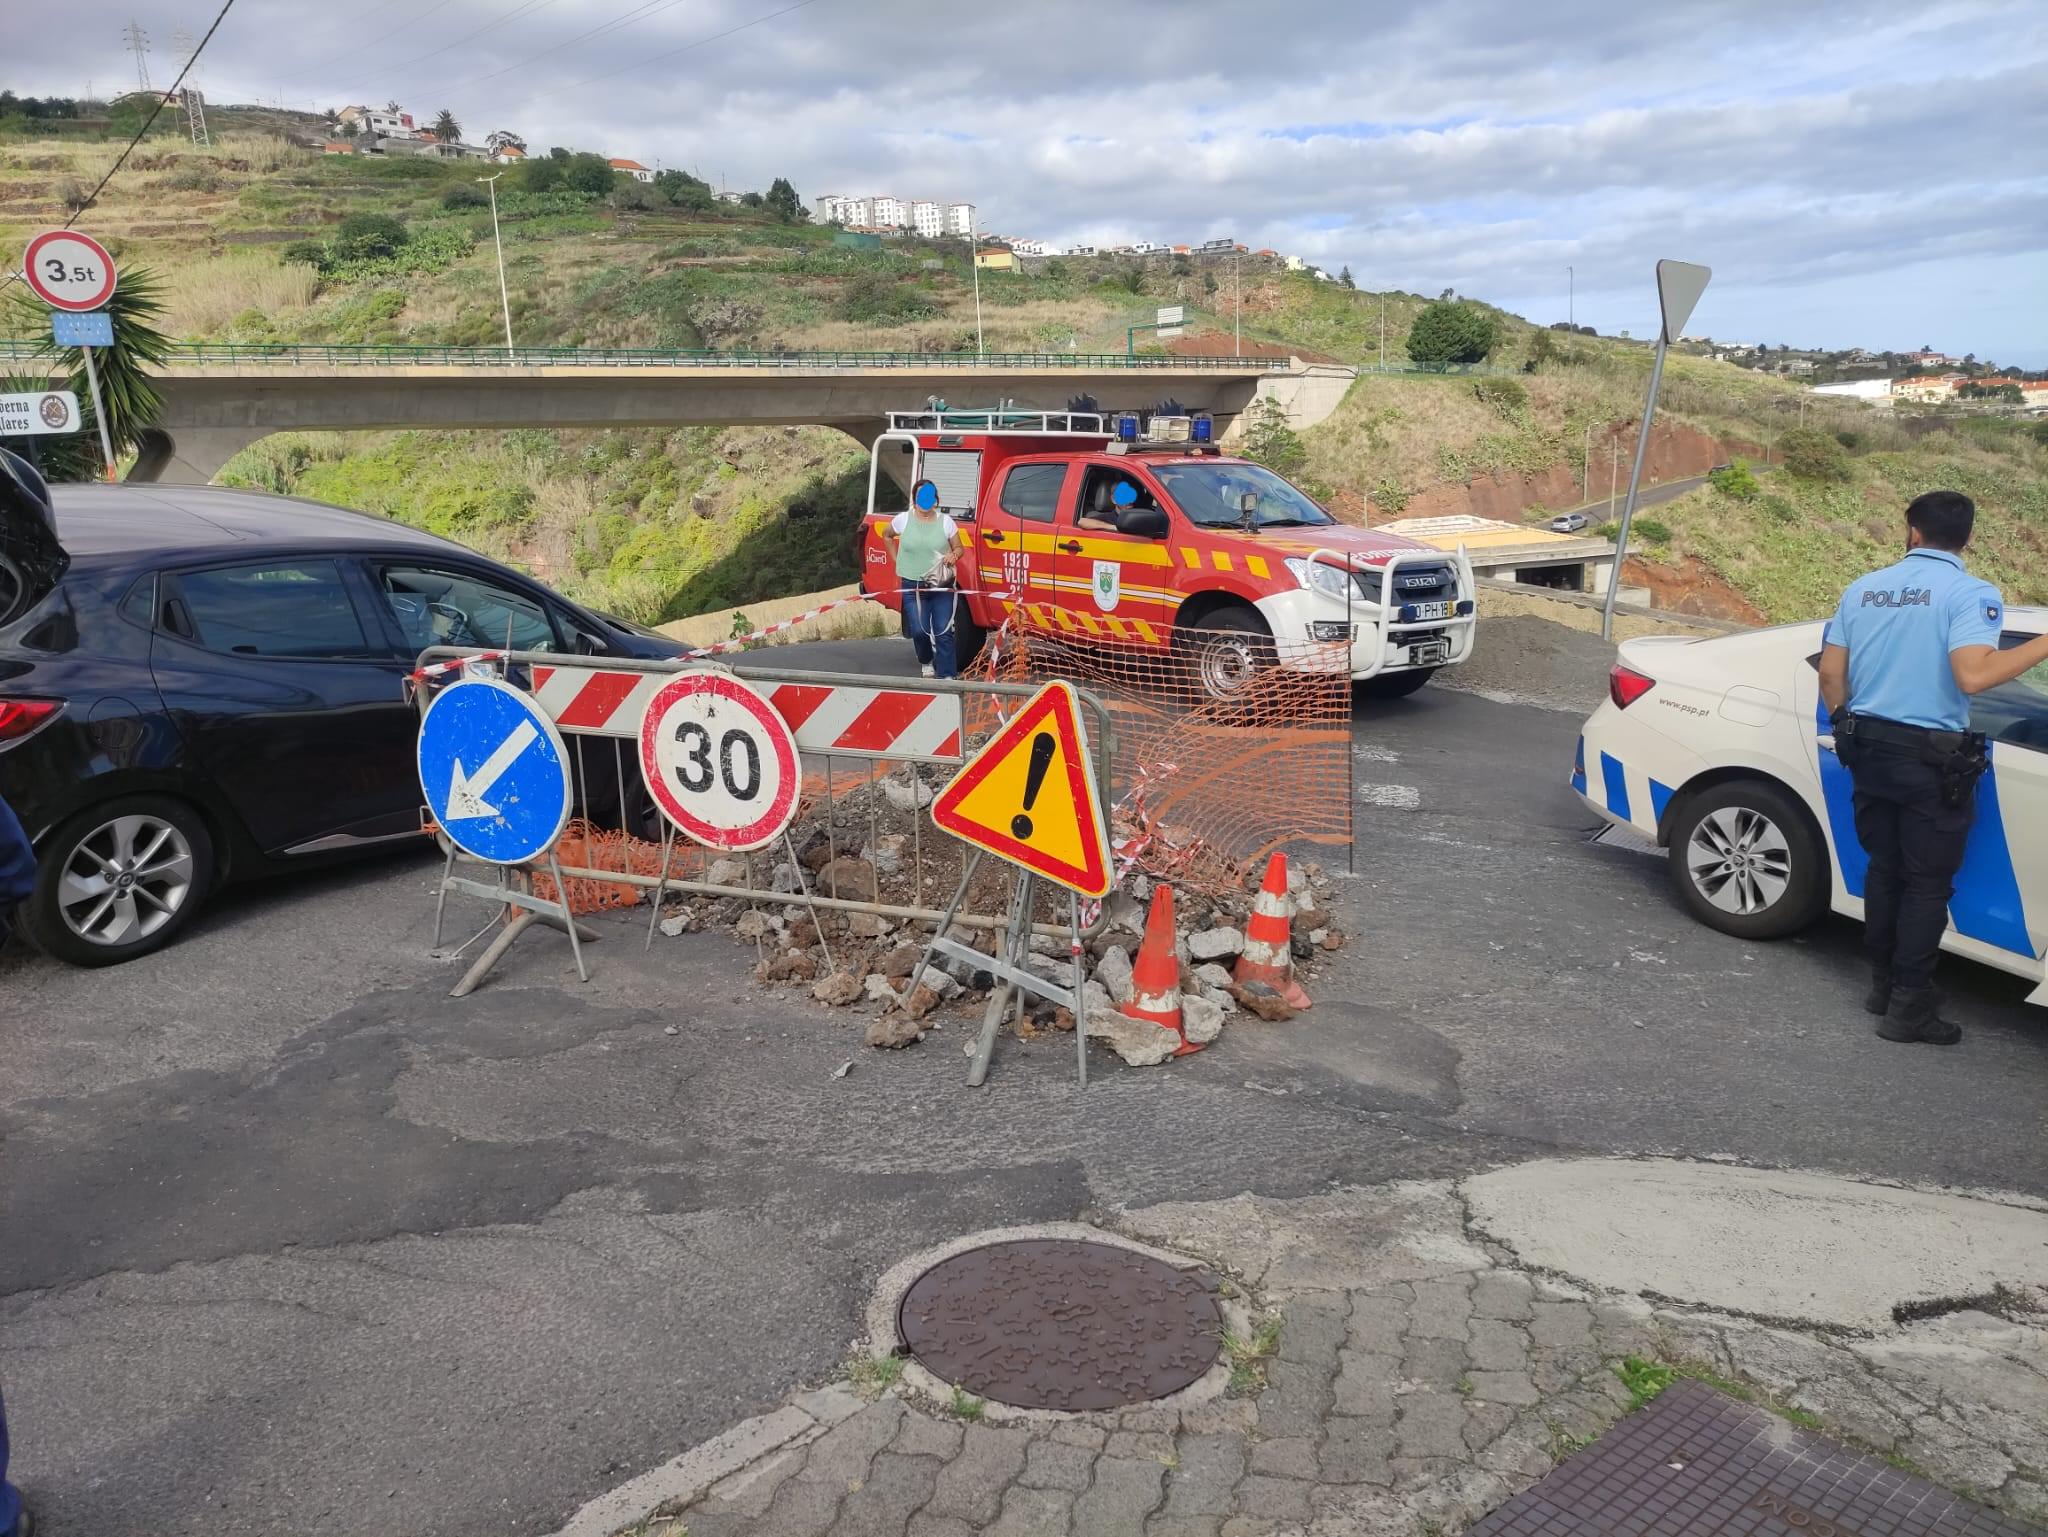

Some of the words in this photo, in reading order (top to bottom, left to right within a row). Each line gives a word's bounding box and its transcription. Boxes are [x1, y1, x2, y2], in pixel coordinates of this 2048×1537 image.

[1002, 552, 1030, 569] 1920
[1405, 576, 1437, 588] ISUZU
[1659, 698, 1710, 717] www.psp.pt
[674, 721, 761, 801] 30
